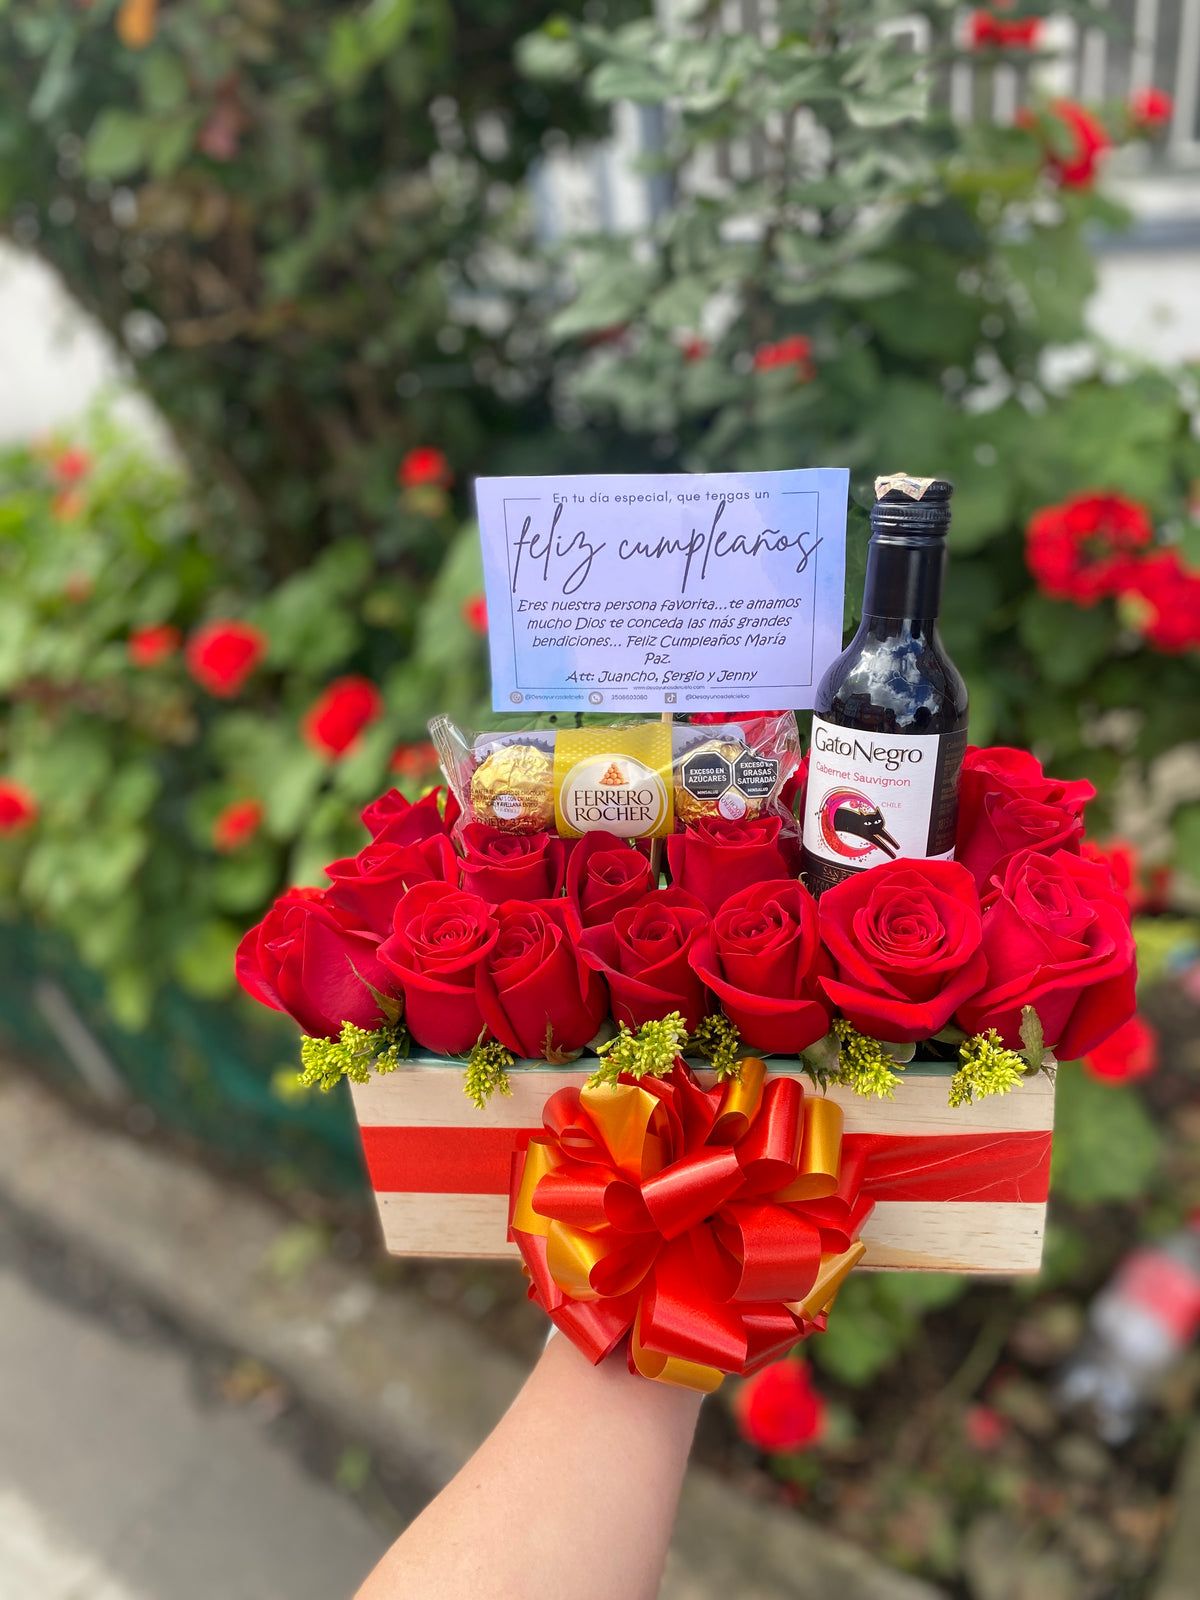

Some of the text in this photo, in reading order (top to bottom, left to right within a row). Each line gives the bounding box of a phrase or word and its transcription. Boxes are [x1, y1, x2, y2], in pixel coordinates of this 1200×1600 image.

[553, 491, 770, 505] En tu día especial, que tengas un
[513, 500, 824, 595] feliz cumpleaños
[517, 599, 548, 612] Eres
[551, 600, 601, 611] nuestra
[604, 600, 657, 612] persona
[746, 598, 802, 609] amamos
[527, 615, 792, 630] mucho Dios te conceda las más grandes
[533, 632, 786, 648] bendiciones... Feliz Cumpleaños María
[644, 652, 671, 665] Paz.
[565, 670, 758, 684] Att: Juancho, Sergio y Jenny
[690, 768, 714, 776] EXCESO
[740, 761, 764, 769] EXCESO
[689, 773, 727, 783] AZÚCARES
[743, 768, 772, 777] GRASAS
[816, 761, 911, 788] Cabernet Sauvignon
[737, 775, 777, 785] SATURADAS
[574, 789, 653, 806] FERRERO
[881, 801, 902, 809] CHILE
[575, 806, 654, 822] ROCHER
